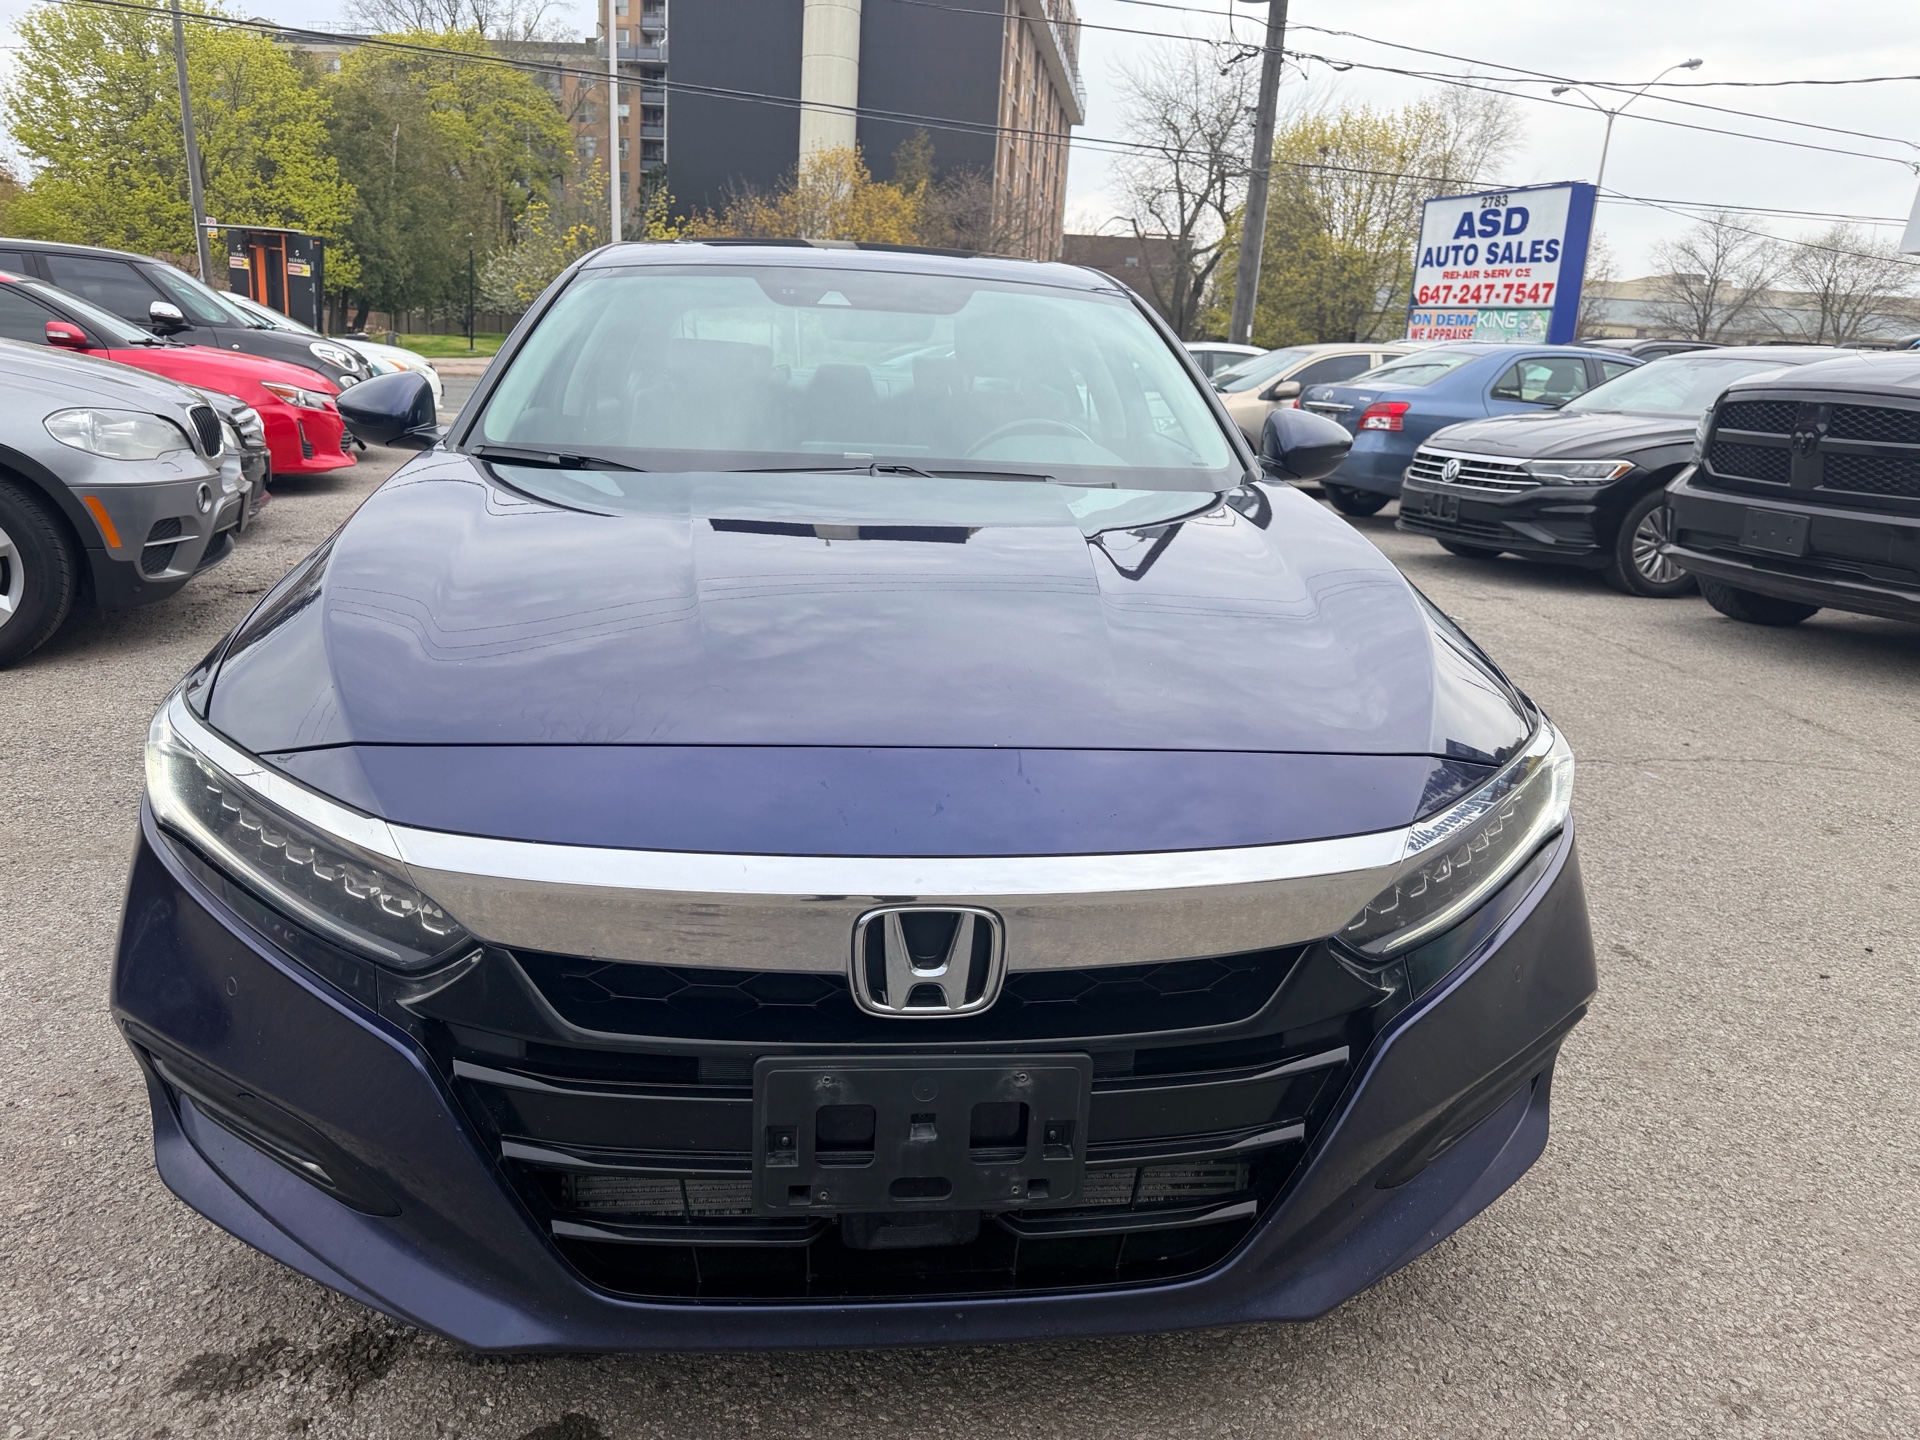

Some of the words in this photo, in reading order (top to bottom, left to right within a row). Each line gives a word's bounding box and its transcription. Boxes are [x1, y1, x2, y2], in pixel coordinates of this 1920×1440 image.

[1481, 195, 1508, 209] 2783
[1453, 207, 1530, 240] ASD
[1421, 243, 1479, 268] AUTO
[1485, 239, 1560, 265] SALES
[1483, 268, 1531, 279] SERVCE
[1418, 283, 1555, 305] 647-247-7547
[1412, 313, 1433, 326] ON
[1476, 310, 1518, 330] KING
[1410, 328, 1424, 340] WE
[1426, 328, 1474, 340] APPRAISE
